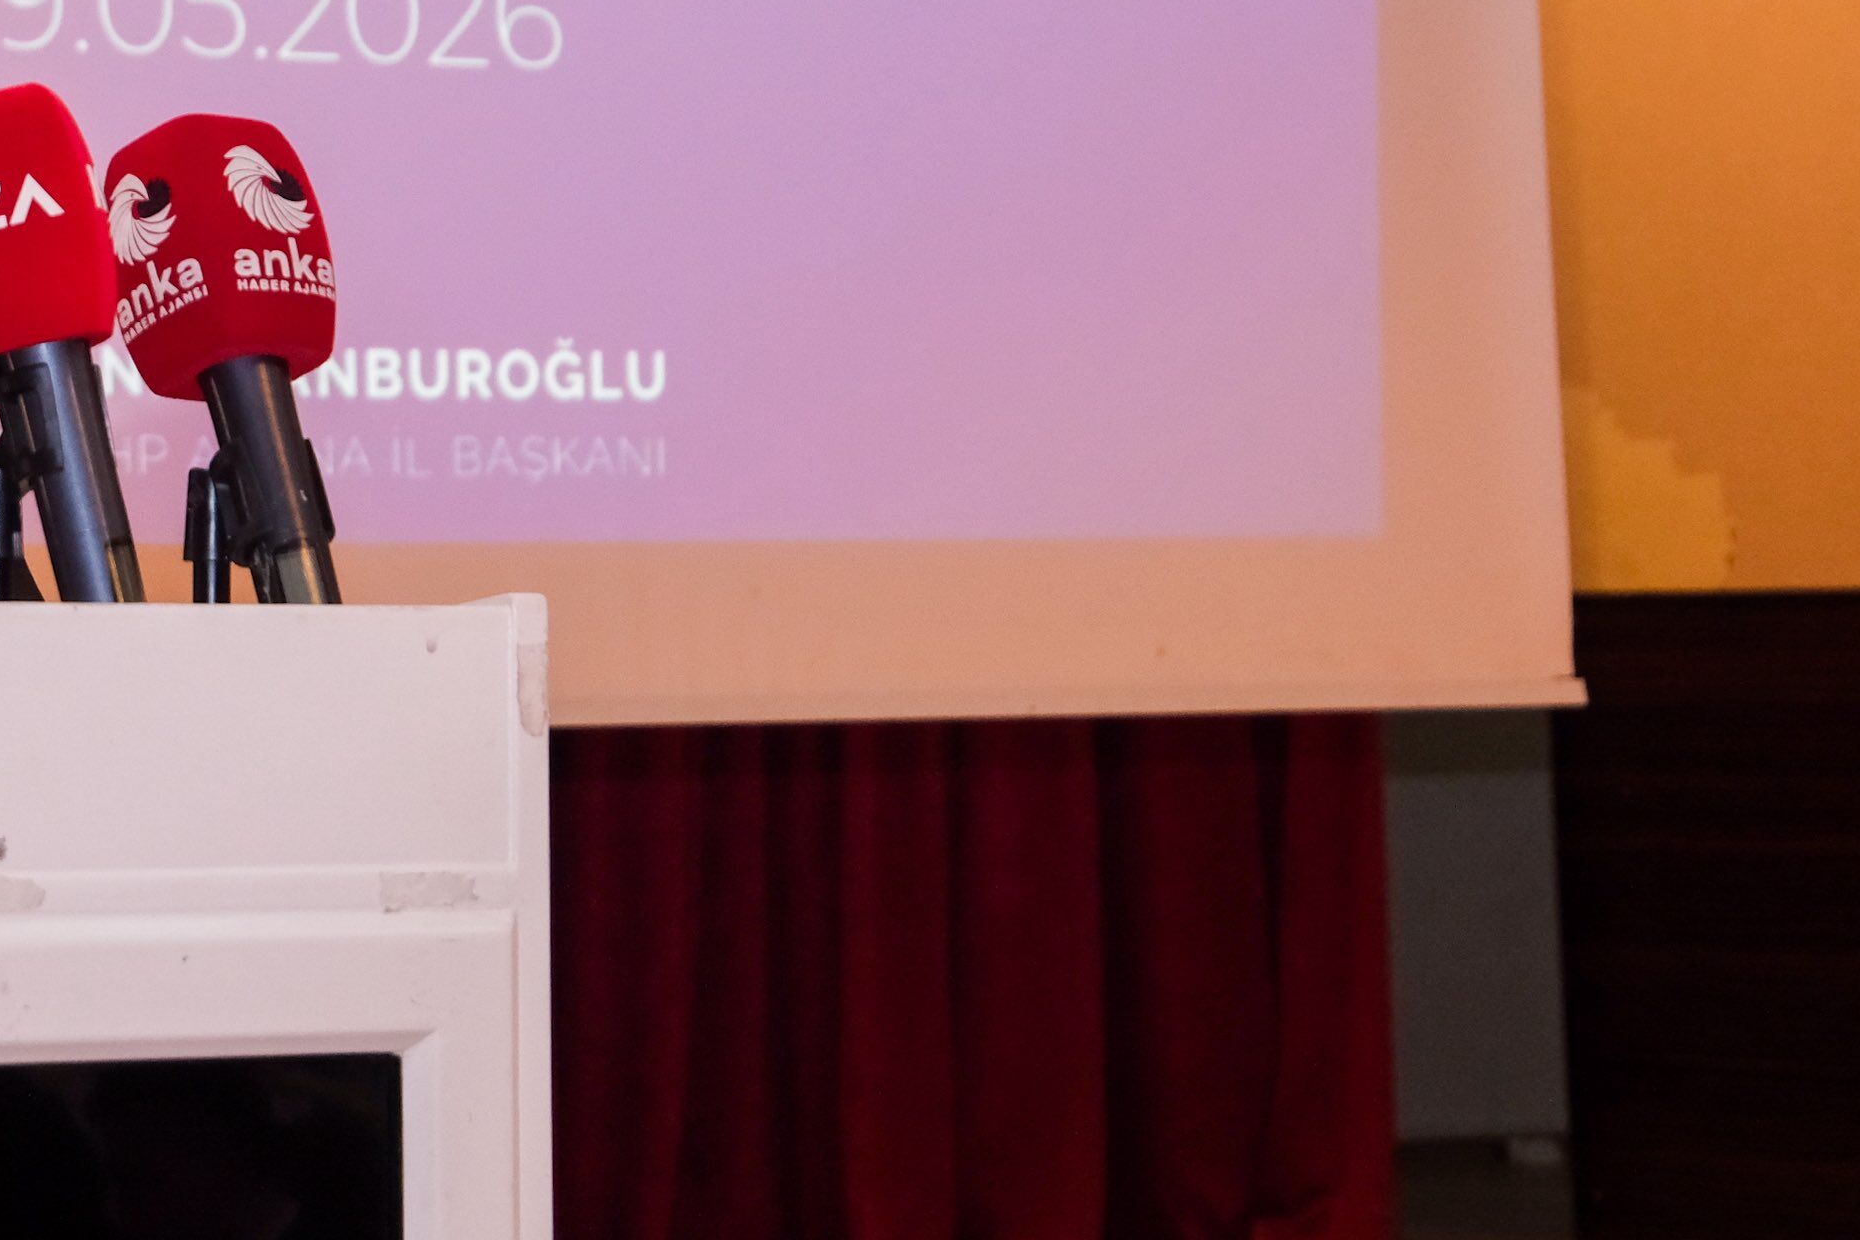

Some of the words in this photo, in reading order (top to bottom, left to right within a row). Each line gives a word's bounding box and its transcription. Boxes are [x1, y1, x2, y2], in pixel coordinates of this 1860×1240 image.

[233, 236, 335, 289] anka
[237, 278, 290, 293] HABER
[116, 257, 205, 330] anka
[291, 336, 667, 402] NBUROĞLU
[114, 431, 170, 475] HP
[451, 433, 668, 484] BAŞKANI
